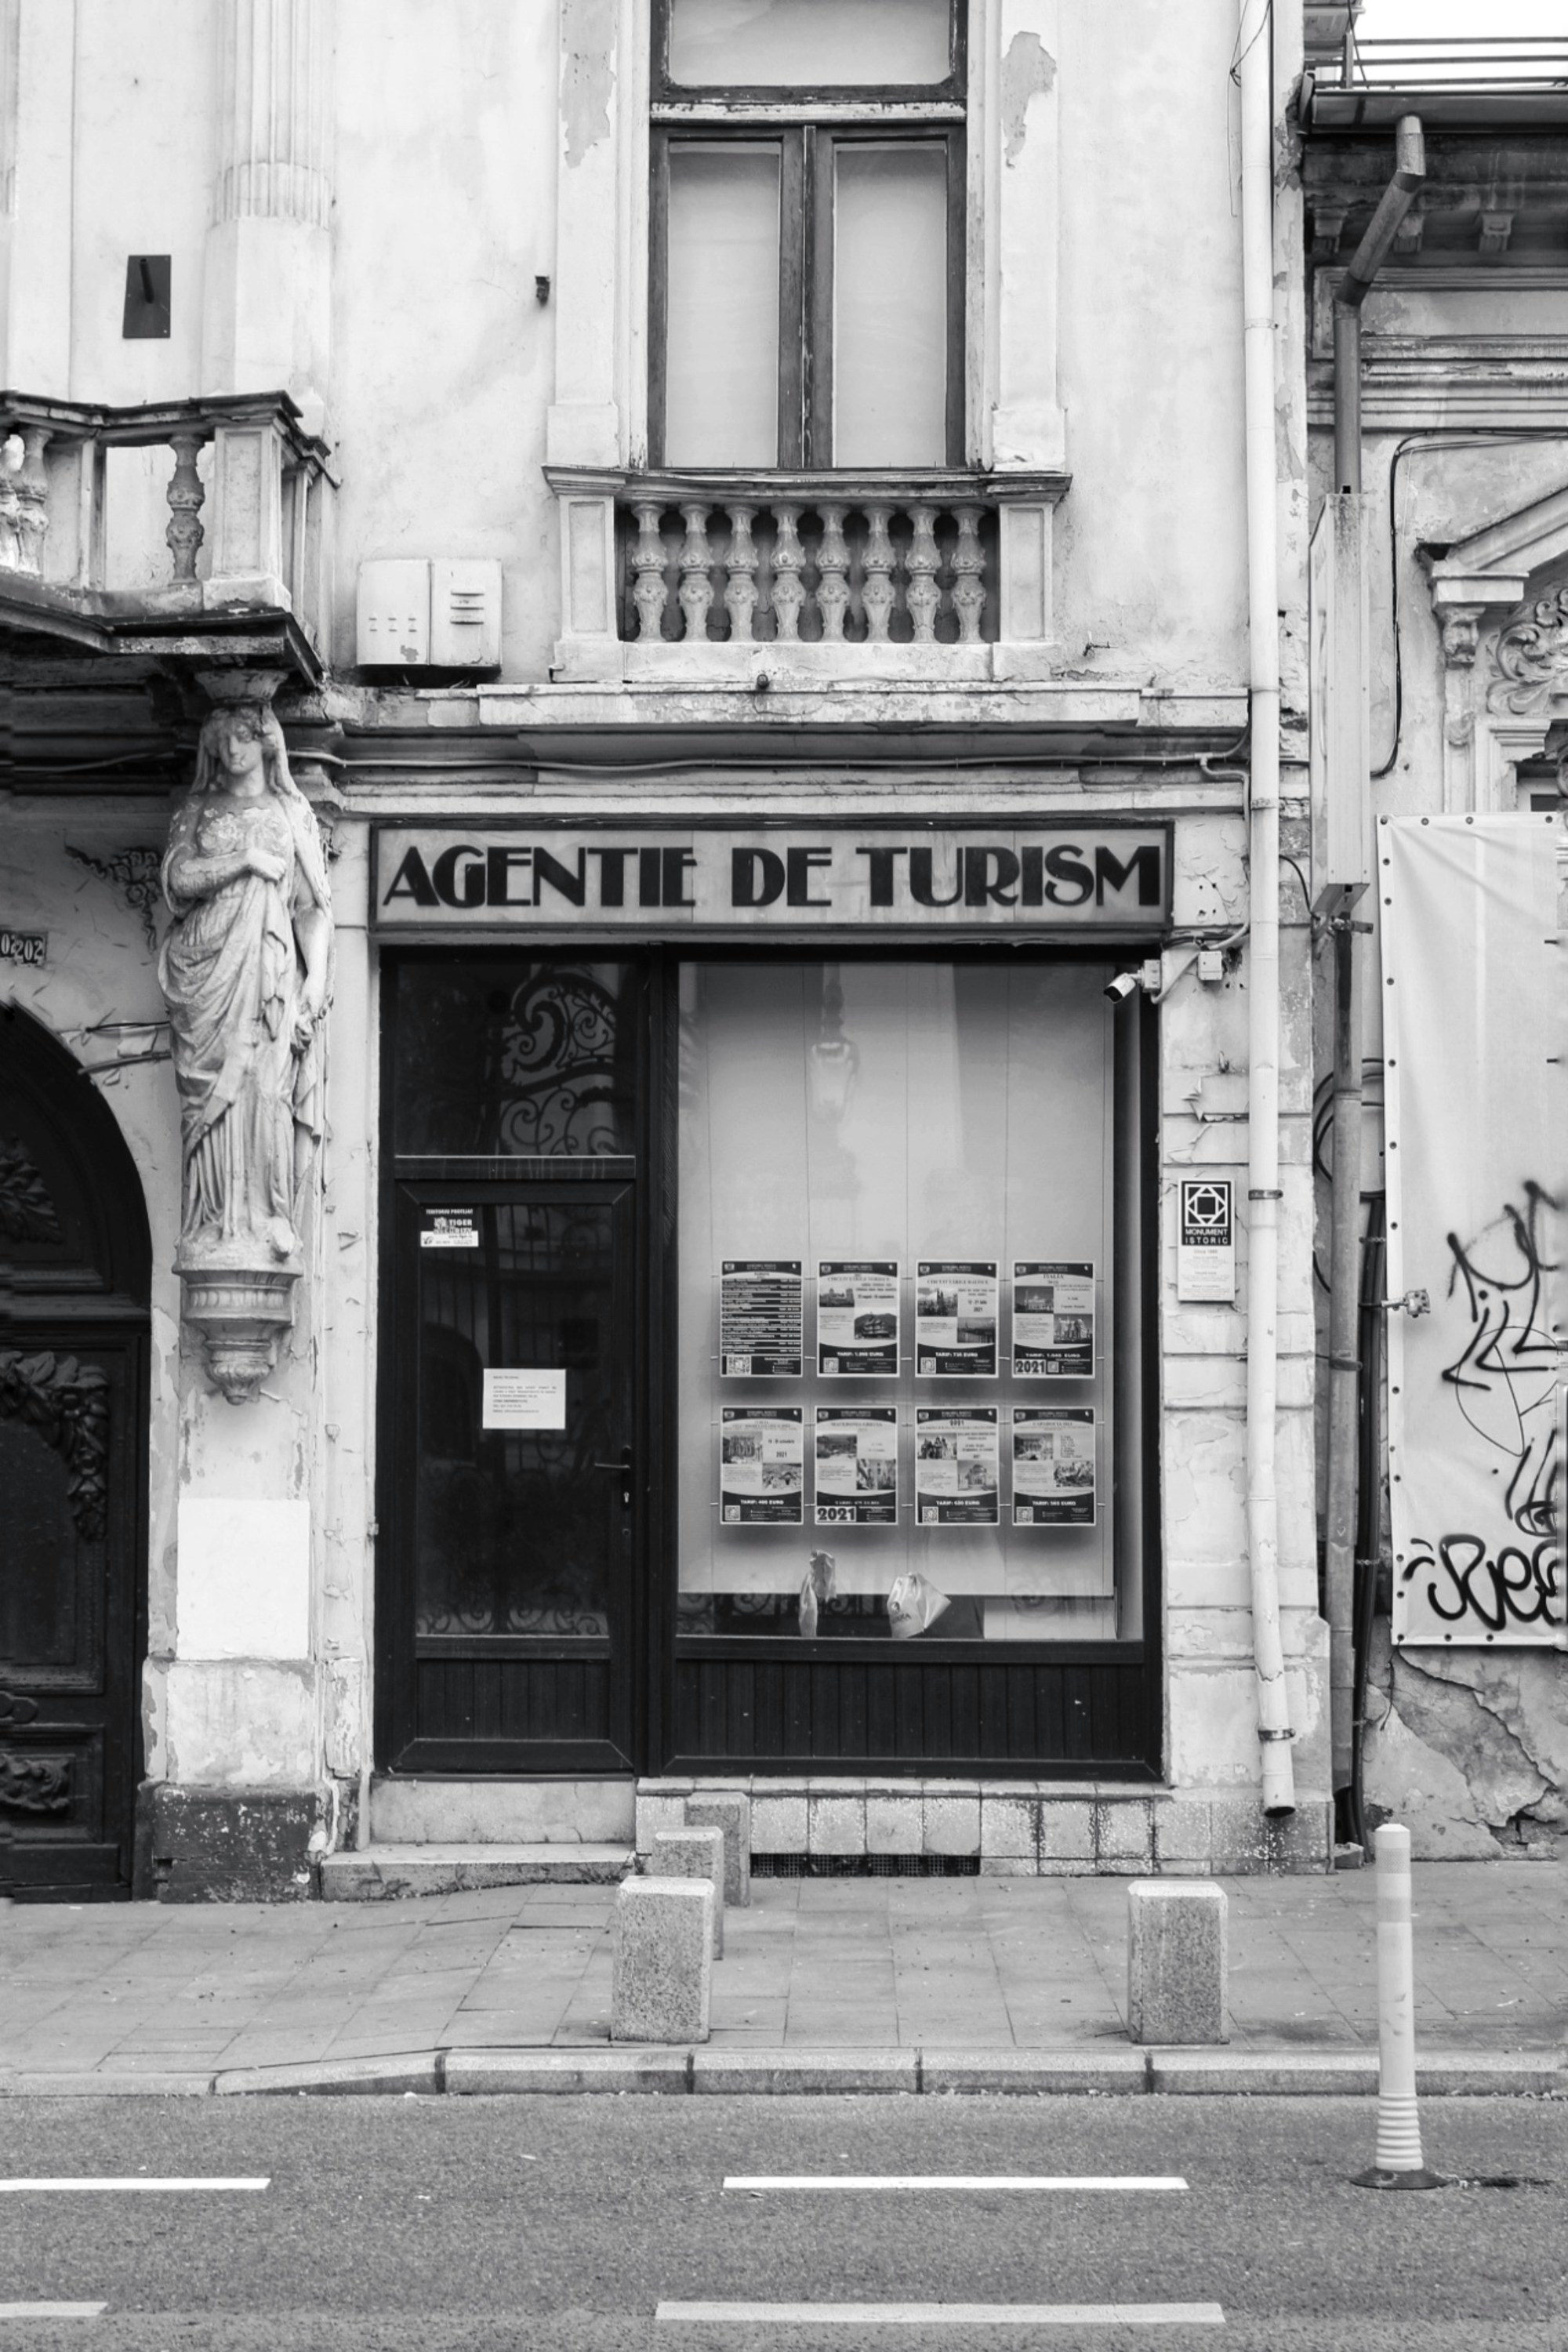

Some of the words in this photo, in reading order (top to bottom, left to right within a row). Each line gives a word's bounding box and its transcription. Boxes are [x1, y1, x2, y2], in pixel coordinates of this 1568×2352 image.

[383, 844, 698, 908] AGENTIE
[731, 846, 832, 906] DE
[856, 844, 1161, 907] TURISM
[1016, 1360, 1044, 1373] 2021
[818, 1507, 855, 1521] 2021
